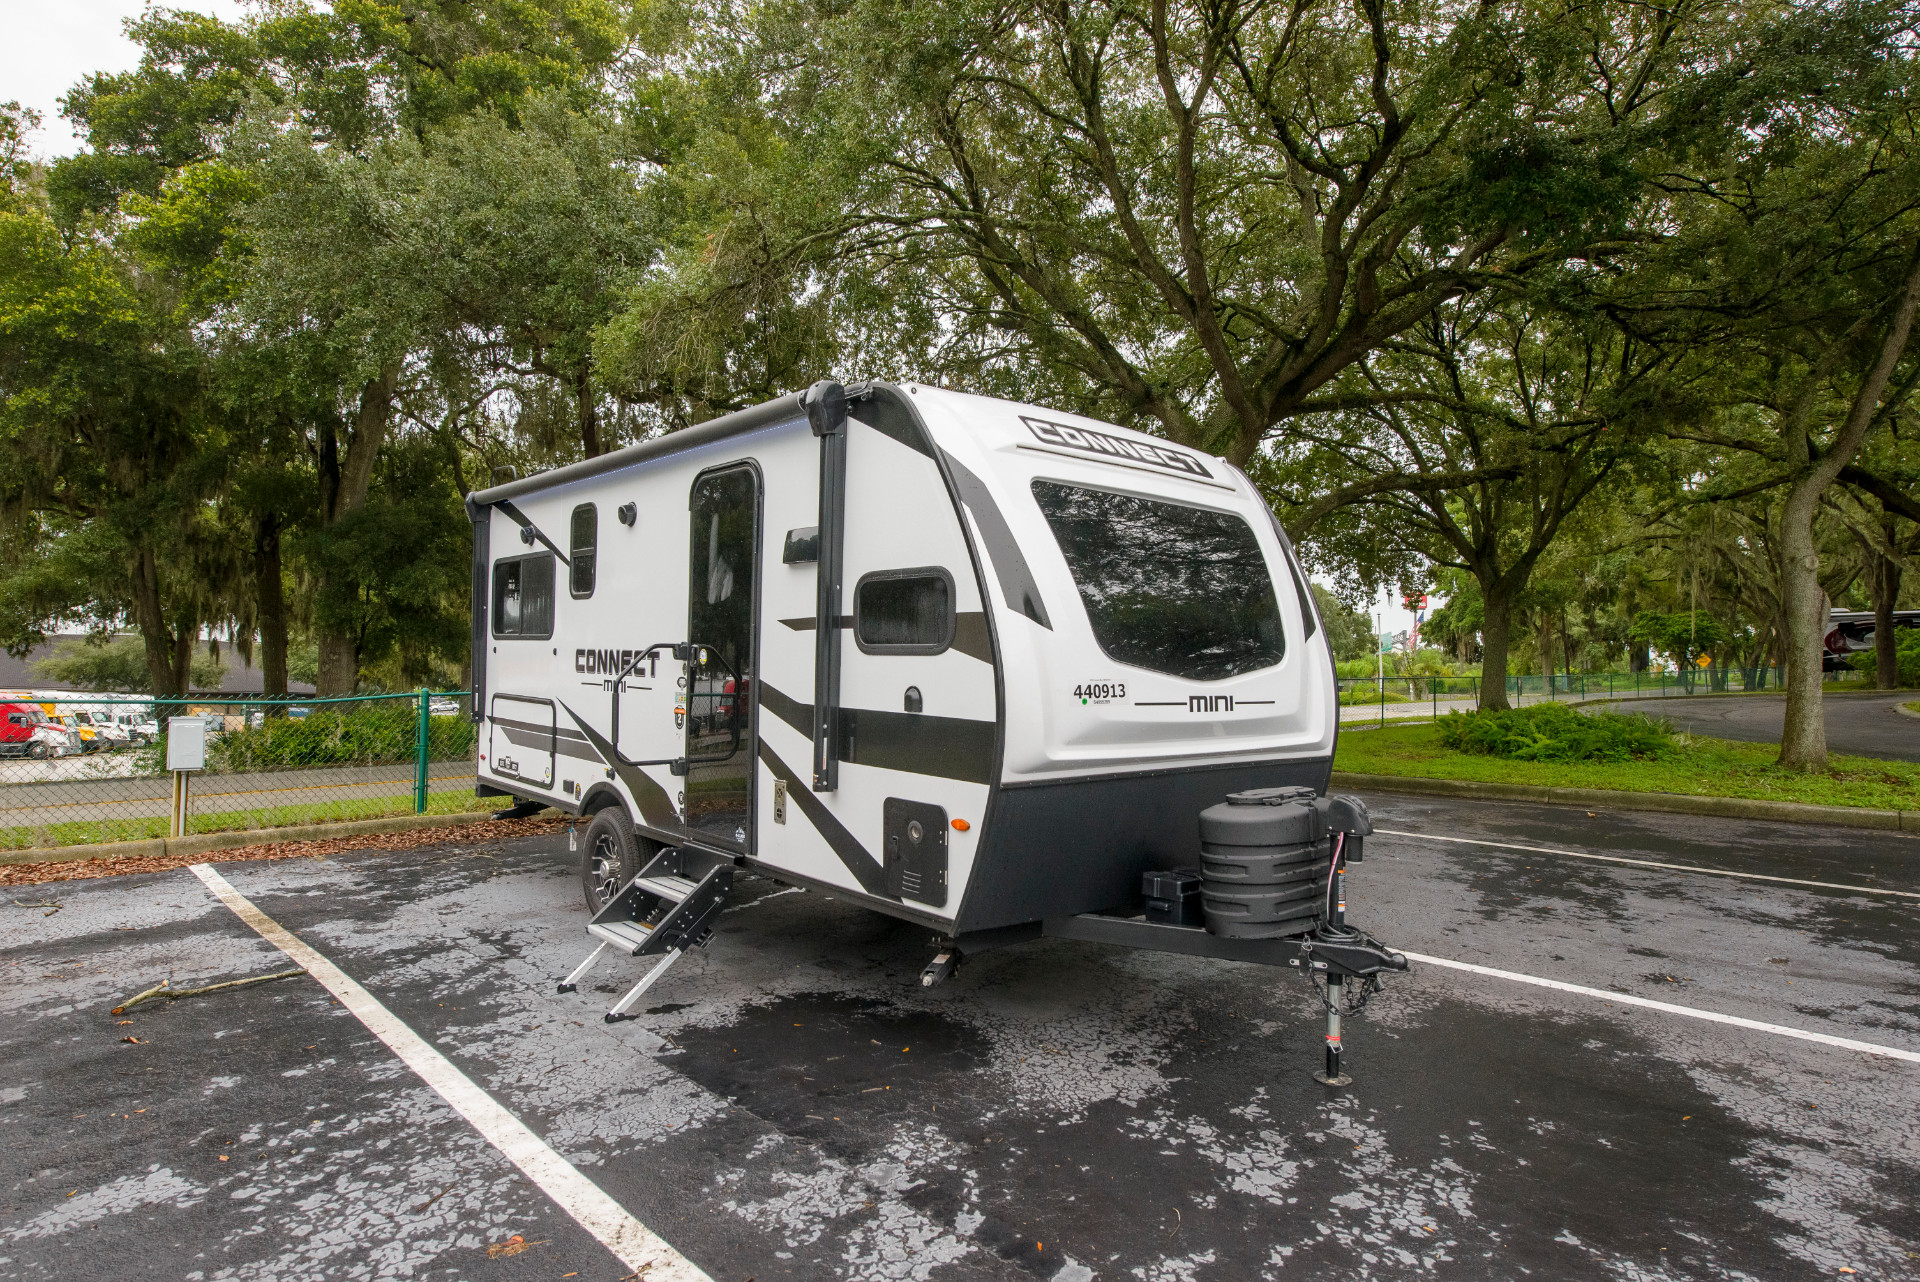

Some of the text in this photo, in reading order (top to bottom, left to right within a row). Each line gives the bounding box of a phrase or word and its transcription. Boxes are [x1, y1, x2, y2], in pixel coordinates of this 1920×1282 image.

[1024, 418, 1204, 474] CONNECT
[575, 648, 660, 679] CONNECT
[1073, 683, 1126, 699] 440913
